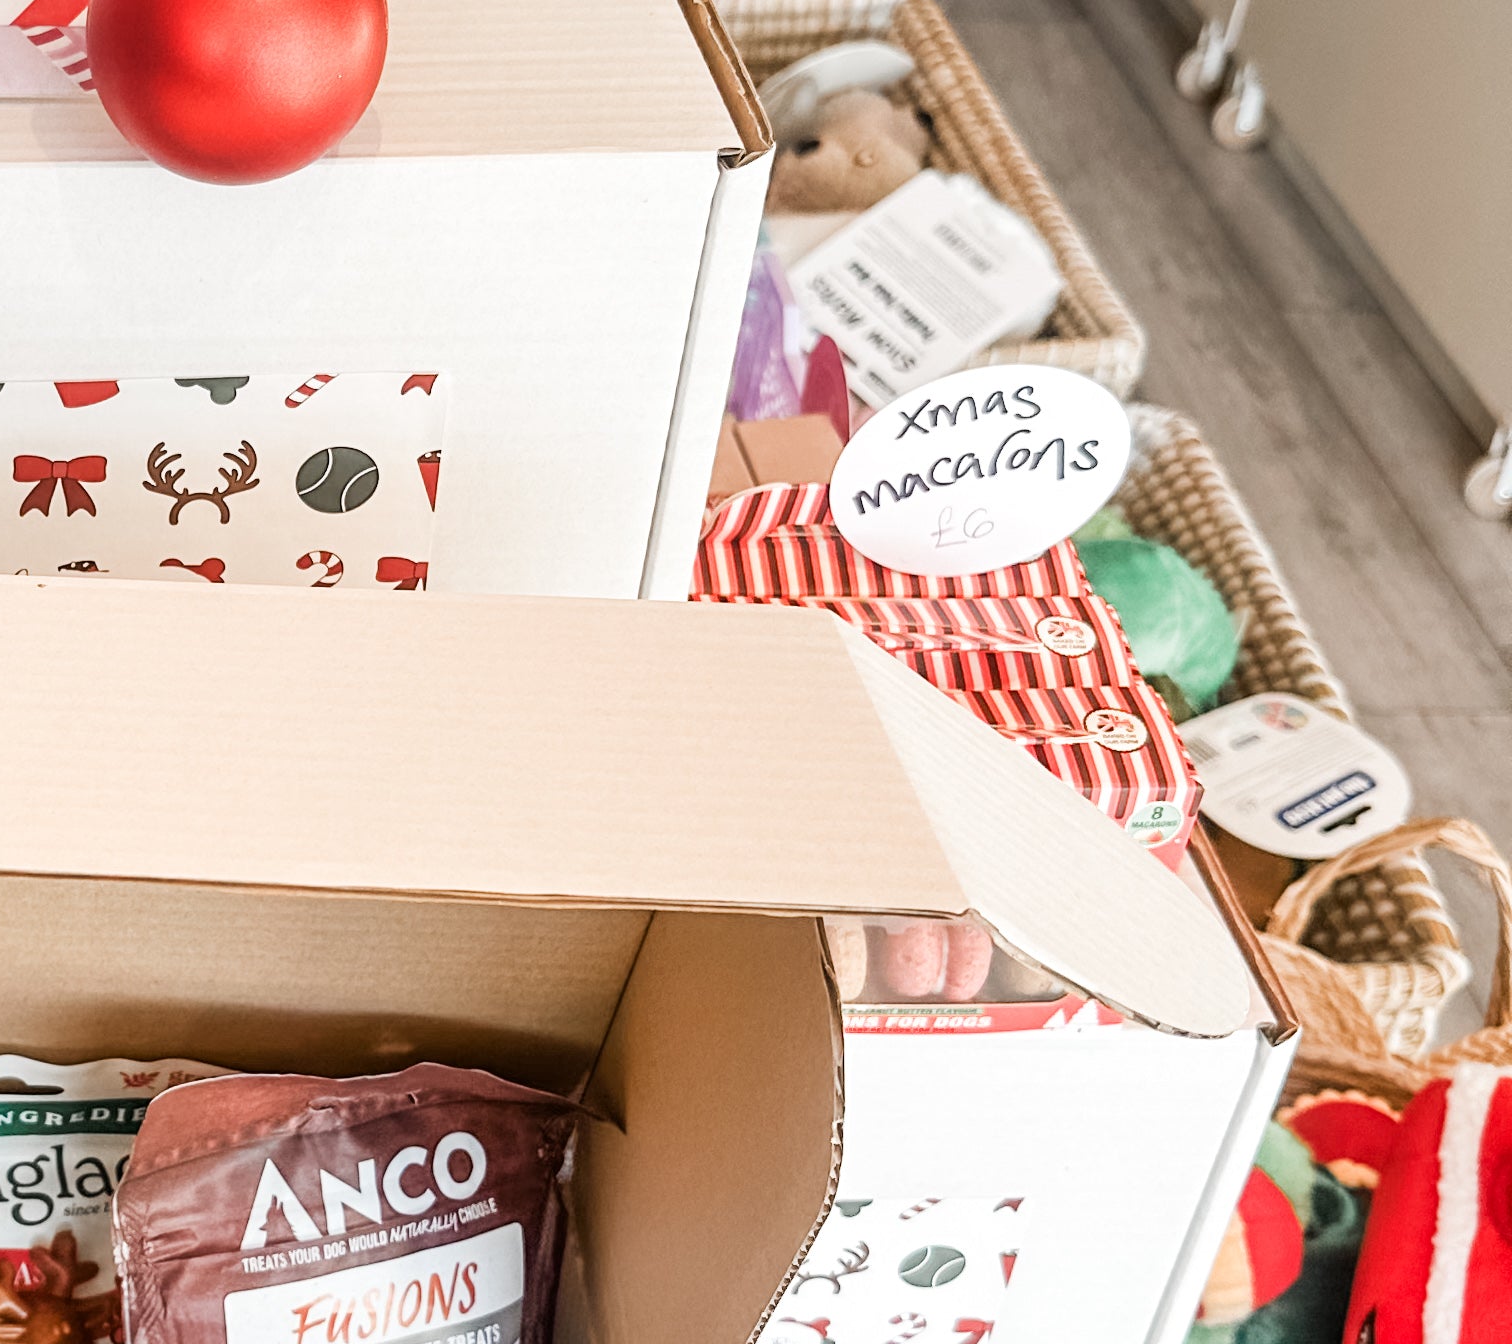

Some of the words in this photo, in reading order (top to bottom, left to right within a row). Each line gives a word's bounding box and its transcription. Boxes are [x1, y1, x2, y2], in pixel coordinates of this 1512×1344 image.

[896, 384, 1043, 441] xmas
[852, 428, 1101, 516] macarons
[930, 506, 996, 550] £6
[1151, 806, 1164, 820] 8
[886, 1016, 929, 1028] FOR
[933, 1016, 993, 1028] DOGS
[240, 1131, 487, 1252] ANCO
[241, 1254, 288, 1274] TREATS
[288, 1248, 322, 1267] YOUR
[323, 1241, 347, 1260] DOG
[349, 1230, 389, 1253] WOULD
[389, 1212, 459, 1243] NATURALLY
[458, 1197, 498, 1225] CHOOSE
